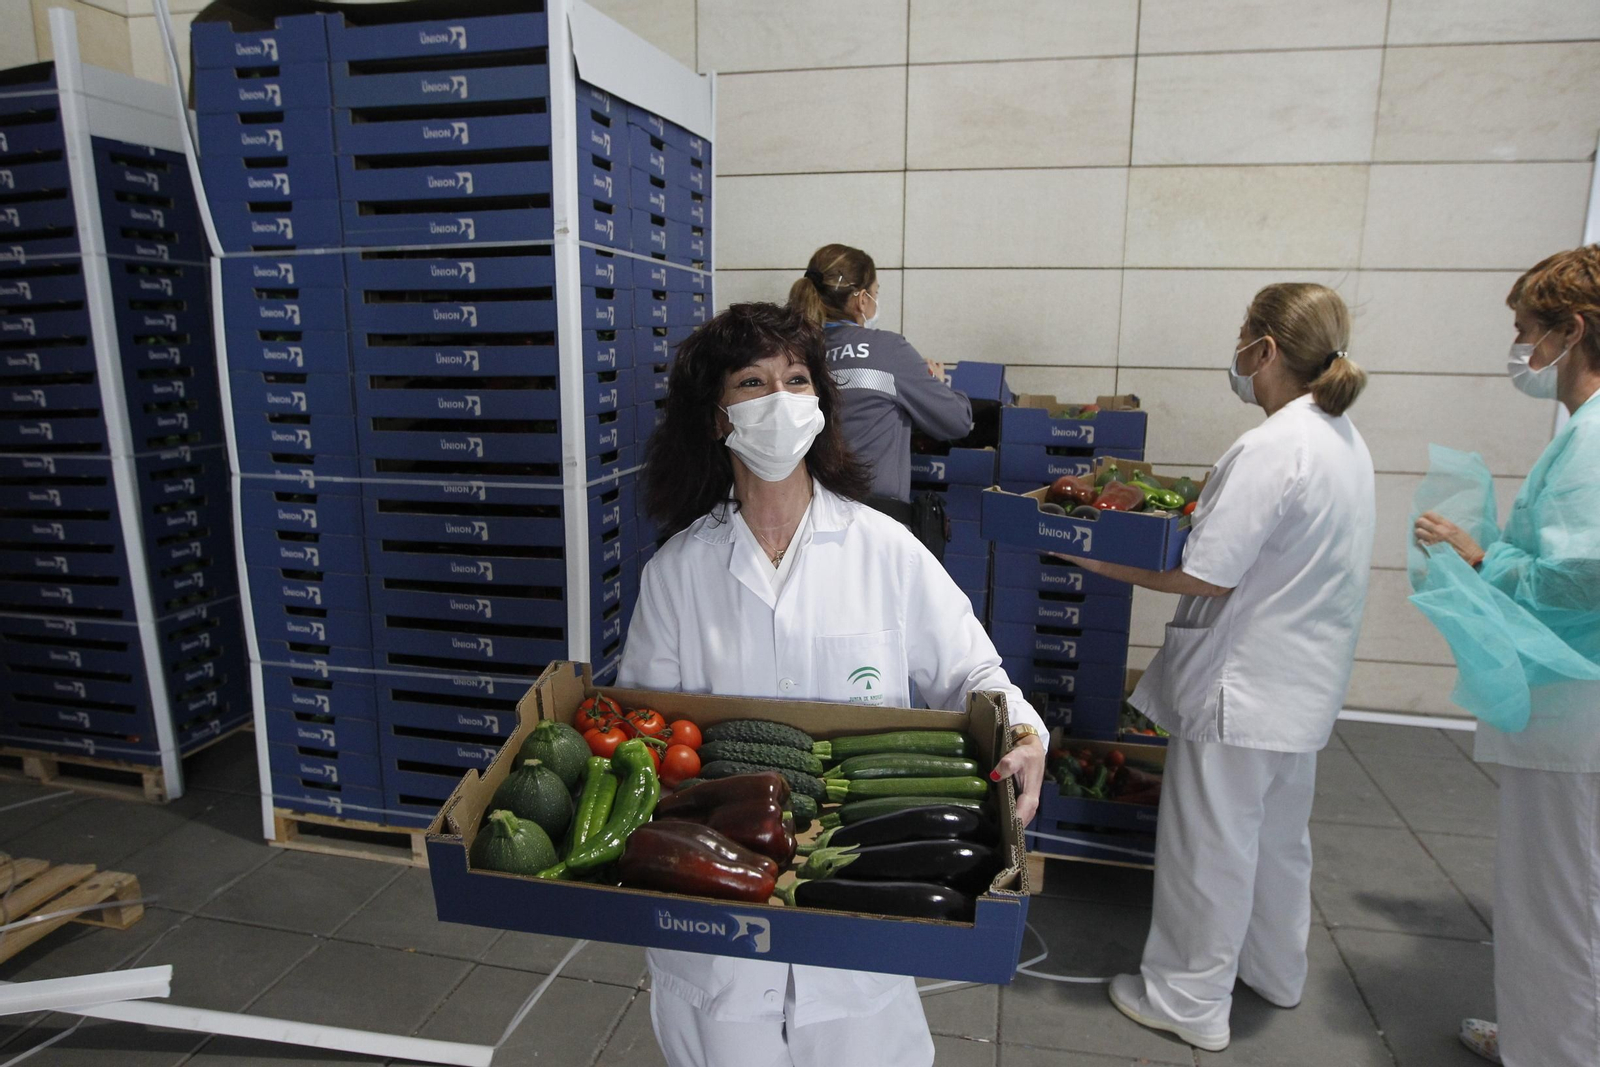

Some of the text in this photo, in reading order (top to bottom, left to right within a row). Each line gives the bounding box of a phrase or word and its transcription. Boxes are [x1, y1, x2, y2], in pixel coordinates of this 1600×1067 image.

[1052, 429, 1078, 437] UNION
[1038, 526, 1071, 540] UNION
[658, 910, 671, 918] LA
[659, 918, 726, 936] UNION
